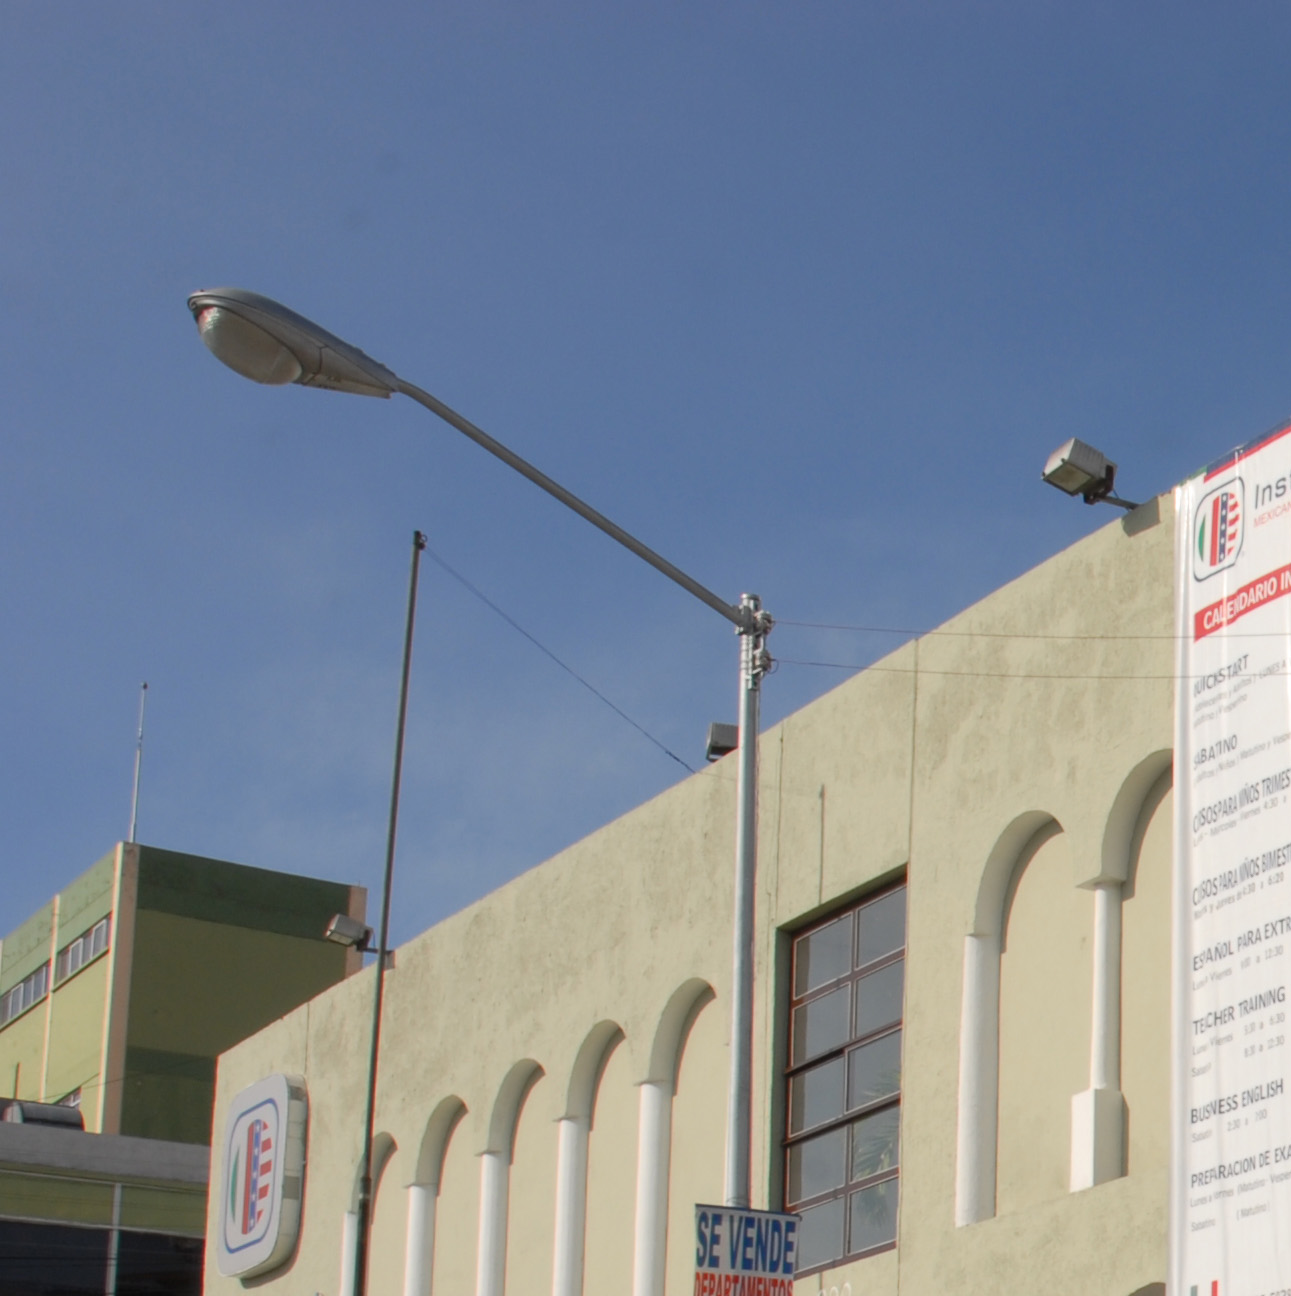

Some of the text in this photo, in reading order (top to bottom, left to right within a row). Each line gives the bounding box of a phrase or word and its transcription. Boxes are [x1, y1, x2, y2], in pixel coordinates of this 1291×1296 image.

[1203, 578, 1277, 630] CALENDARIO
[1193, 806, 1219, 834] CSOS
[1193, 877, 1219, 906] CSOS
[1191, 1078, 1284, 1124] BUSNESS ENGLISH
[1258, 1150, 1271, 1167] DE
[697, 1211, 796, 1274] SE VENDE
